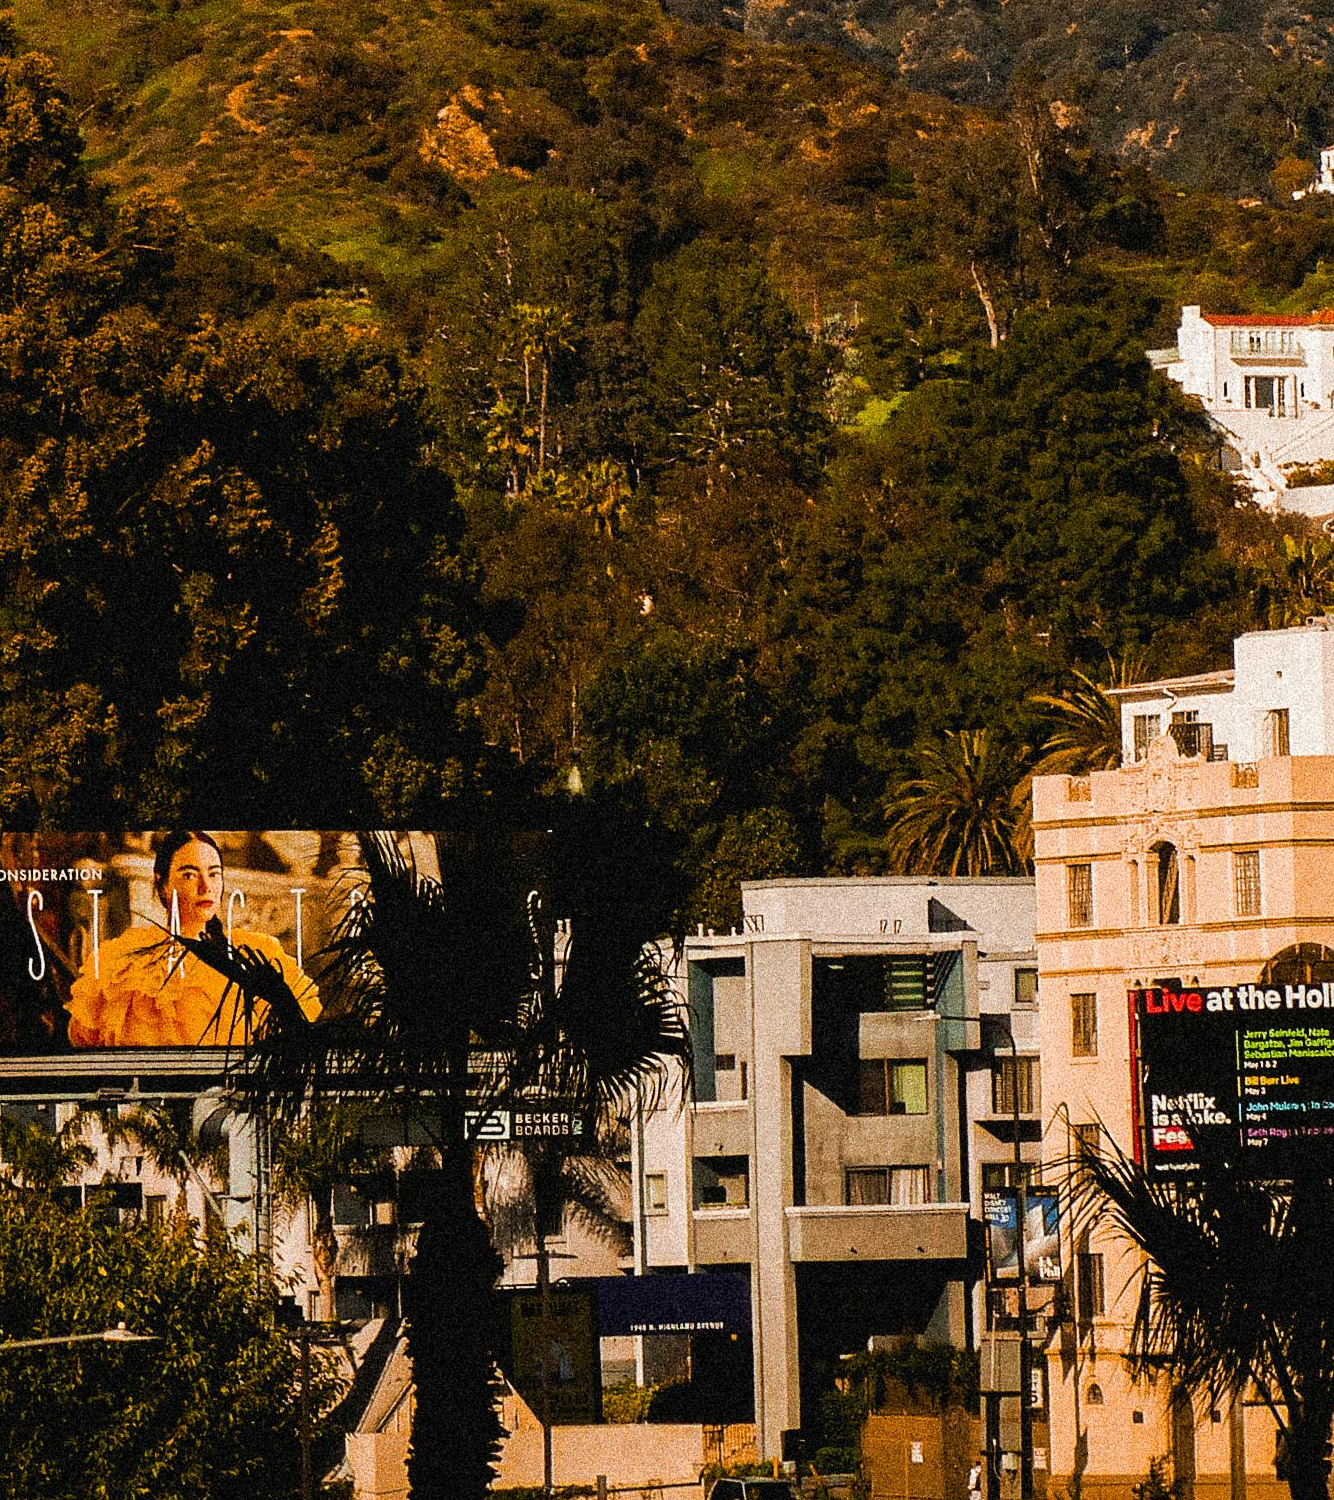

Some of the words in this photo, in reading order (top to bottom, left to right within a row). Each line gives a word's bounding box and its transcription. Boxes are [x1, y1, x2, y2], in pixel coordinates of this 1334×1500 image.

[1146, 986, 1202, 1014] Live
[1206, 988, 1233, 1012] at
[1237, 986, 1281, 1010] the
[1280, 1075, 1300, 1085] Live
[516, 1113, 569, 1124] BECKER
[1186, 1108, 1232, 1125] oke.
[516, 1125, 569, 1136] BOARDS
[1152, 1128, 1188, 1145] Fes
